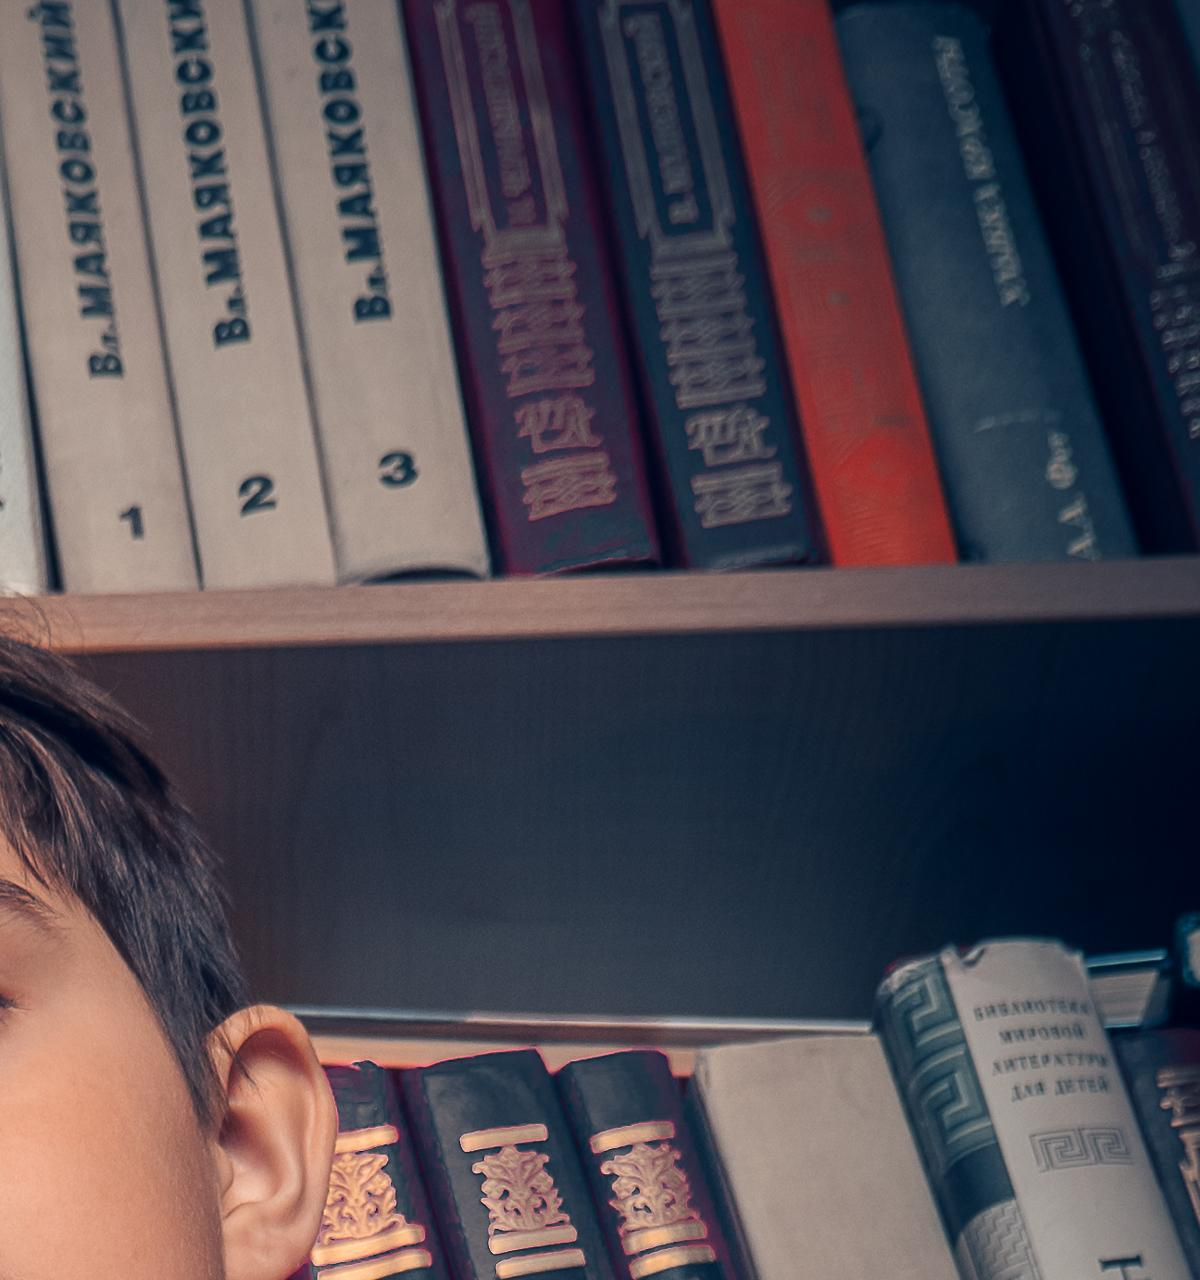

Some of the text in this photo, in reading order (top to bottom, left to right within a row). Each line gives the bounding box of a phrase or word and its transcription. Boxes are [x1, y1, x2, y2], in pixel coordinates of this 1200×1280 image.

[376, 450, 420, 490] 3
[237, 474, 277, 517] 2
[118, 505, 145, 541] 1
[973, 998, 1090, 1021] БИБЛИОТЕКА
[999, 1020, 1085, 1043] МИРОВОЙ
[992, 1053, 1109, 1076] ЛИТЕРАТУРЫ
[1011, 1075, 1110, 1102] ДЛЯ ДЕТЕЙ
